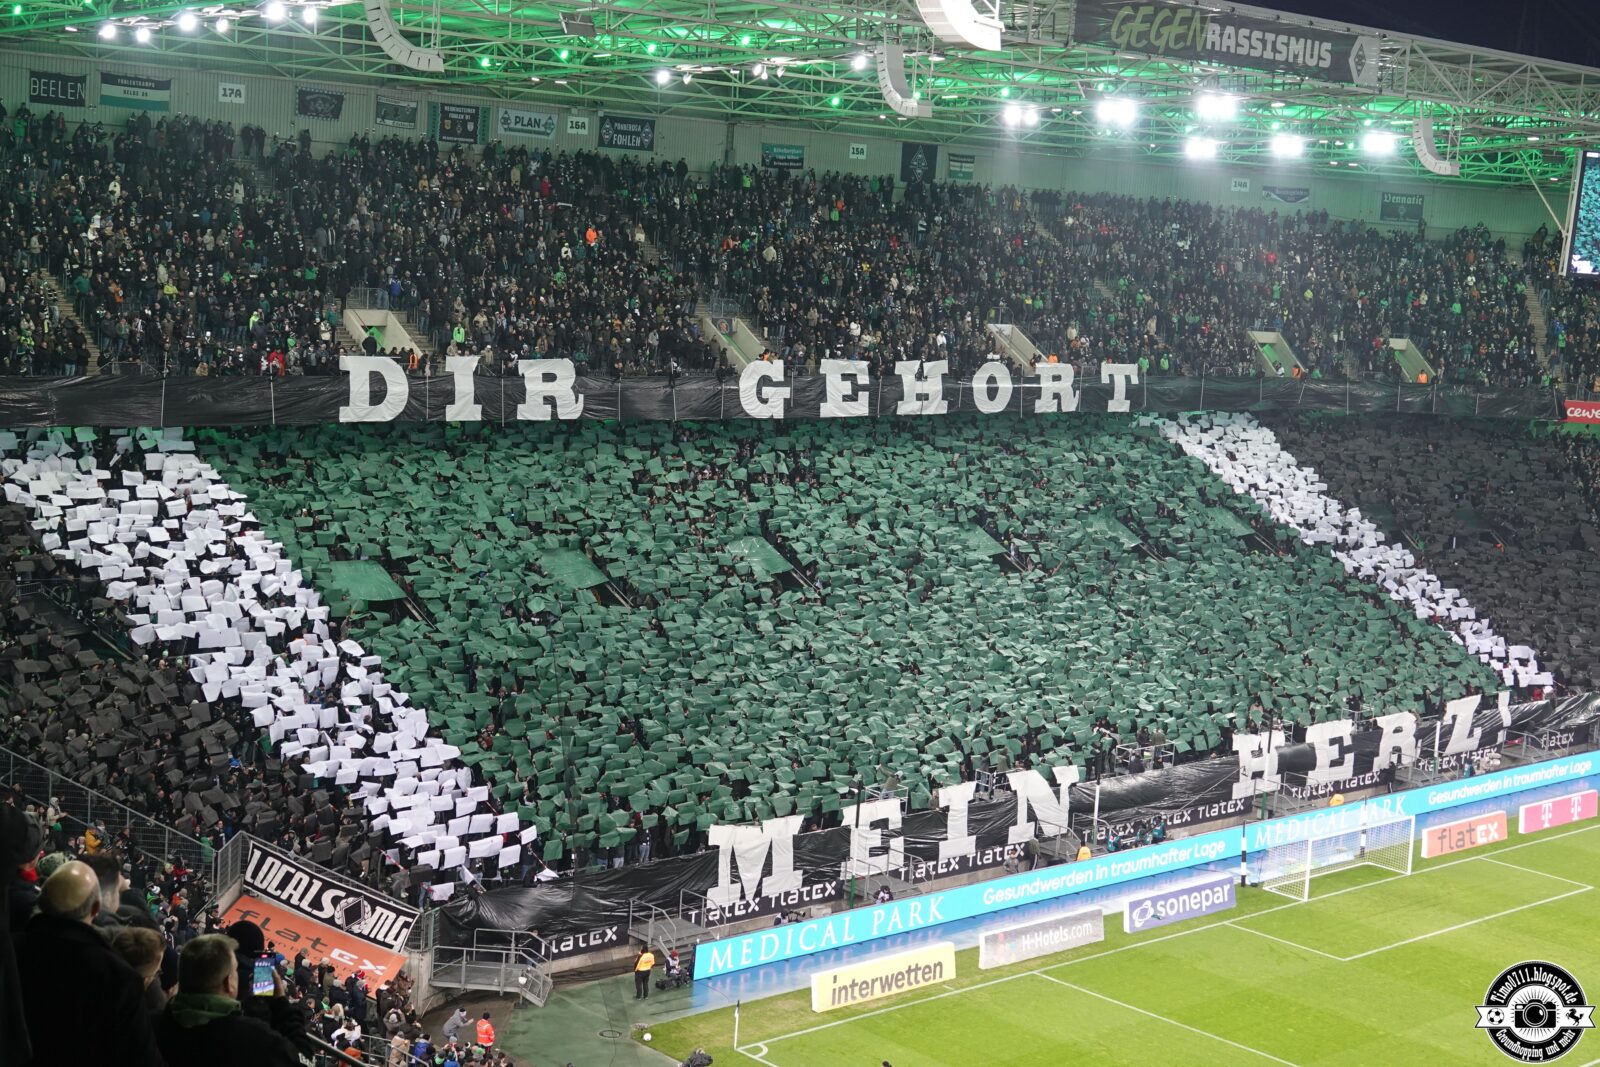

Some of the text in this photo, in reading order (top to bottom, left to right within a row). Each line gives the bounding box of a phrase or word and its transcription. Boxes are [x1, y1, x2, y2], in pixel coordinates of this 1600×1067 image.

[1110, 5, 1332, 68] GEGEN RASSISMUS
[30, 77, 86, 100] BEELEN
[221, 87, 242, 97] 17A
[514, 115, 542, 129] PLAN
[569, 121, 586, 130] 16A
[612, 133, 641, 147] FOHLEN
[851, 147, 865, 156] 15A
[338, 355, 584, 423] DIR
[1428, 758, 1593, 806] Gesundwerden in traumhafter Lage
[1541, 803, 1553, 828] T
[1571, 796, 1581, 821] T
[706, 764, 1080, 906] MEIN
[1082, 822, 1135, 841] fatEX
[1254, 808, 1350, 849] MEDICAL
[1438, 820, 1499, 852] flatEX
[245, 848, 346, 919] LOCALS
[898, 856, 960, 880] fatEX
[983, 837, 1225, 906] Gesundwerden in traumhafter Lage
[688, 897, 760, 924] fatEX
[1157, 882, 1231, 917] sonepar
[235, 908, 387, 977] flatEX
[708, 895, 945, 974] MEDICAL PARK
[1022, 922, 1093, 952] H-Hotels.com
[831, 959, 943, 1007] interwetten
